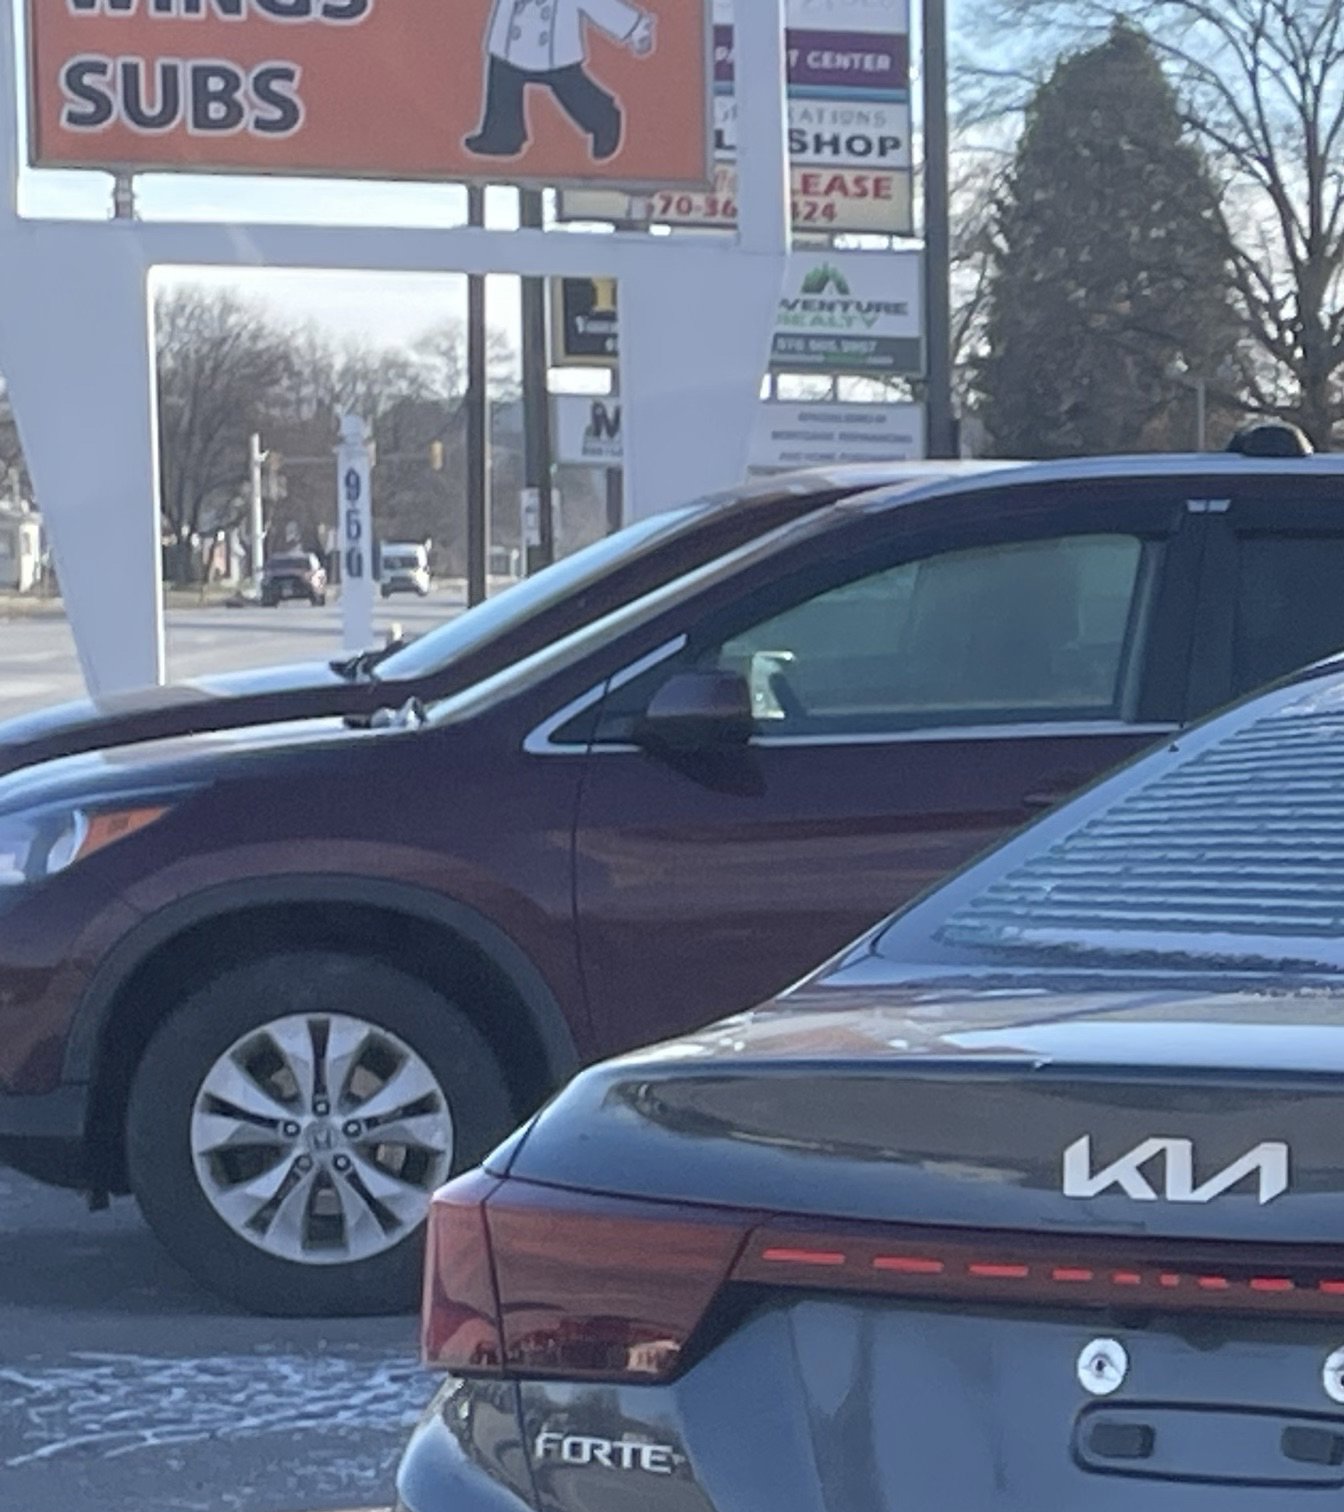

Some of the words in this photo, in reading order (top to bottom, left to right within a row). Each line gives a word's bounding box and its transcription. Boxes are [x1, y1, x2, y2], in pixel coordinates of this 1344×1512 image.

[806, 51, 891, 72] CENTER
[61, 56, 303, 136] SUBS
[788, 127, 901, 157] SHOP
[779, 298, 909, 316] VENTURE
[1063, 1134, 1290, 1206] KIA
[536, 1431, 673, 1475] FORTE
